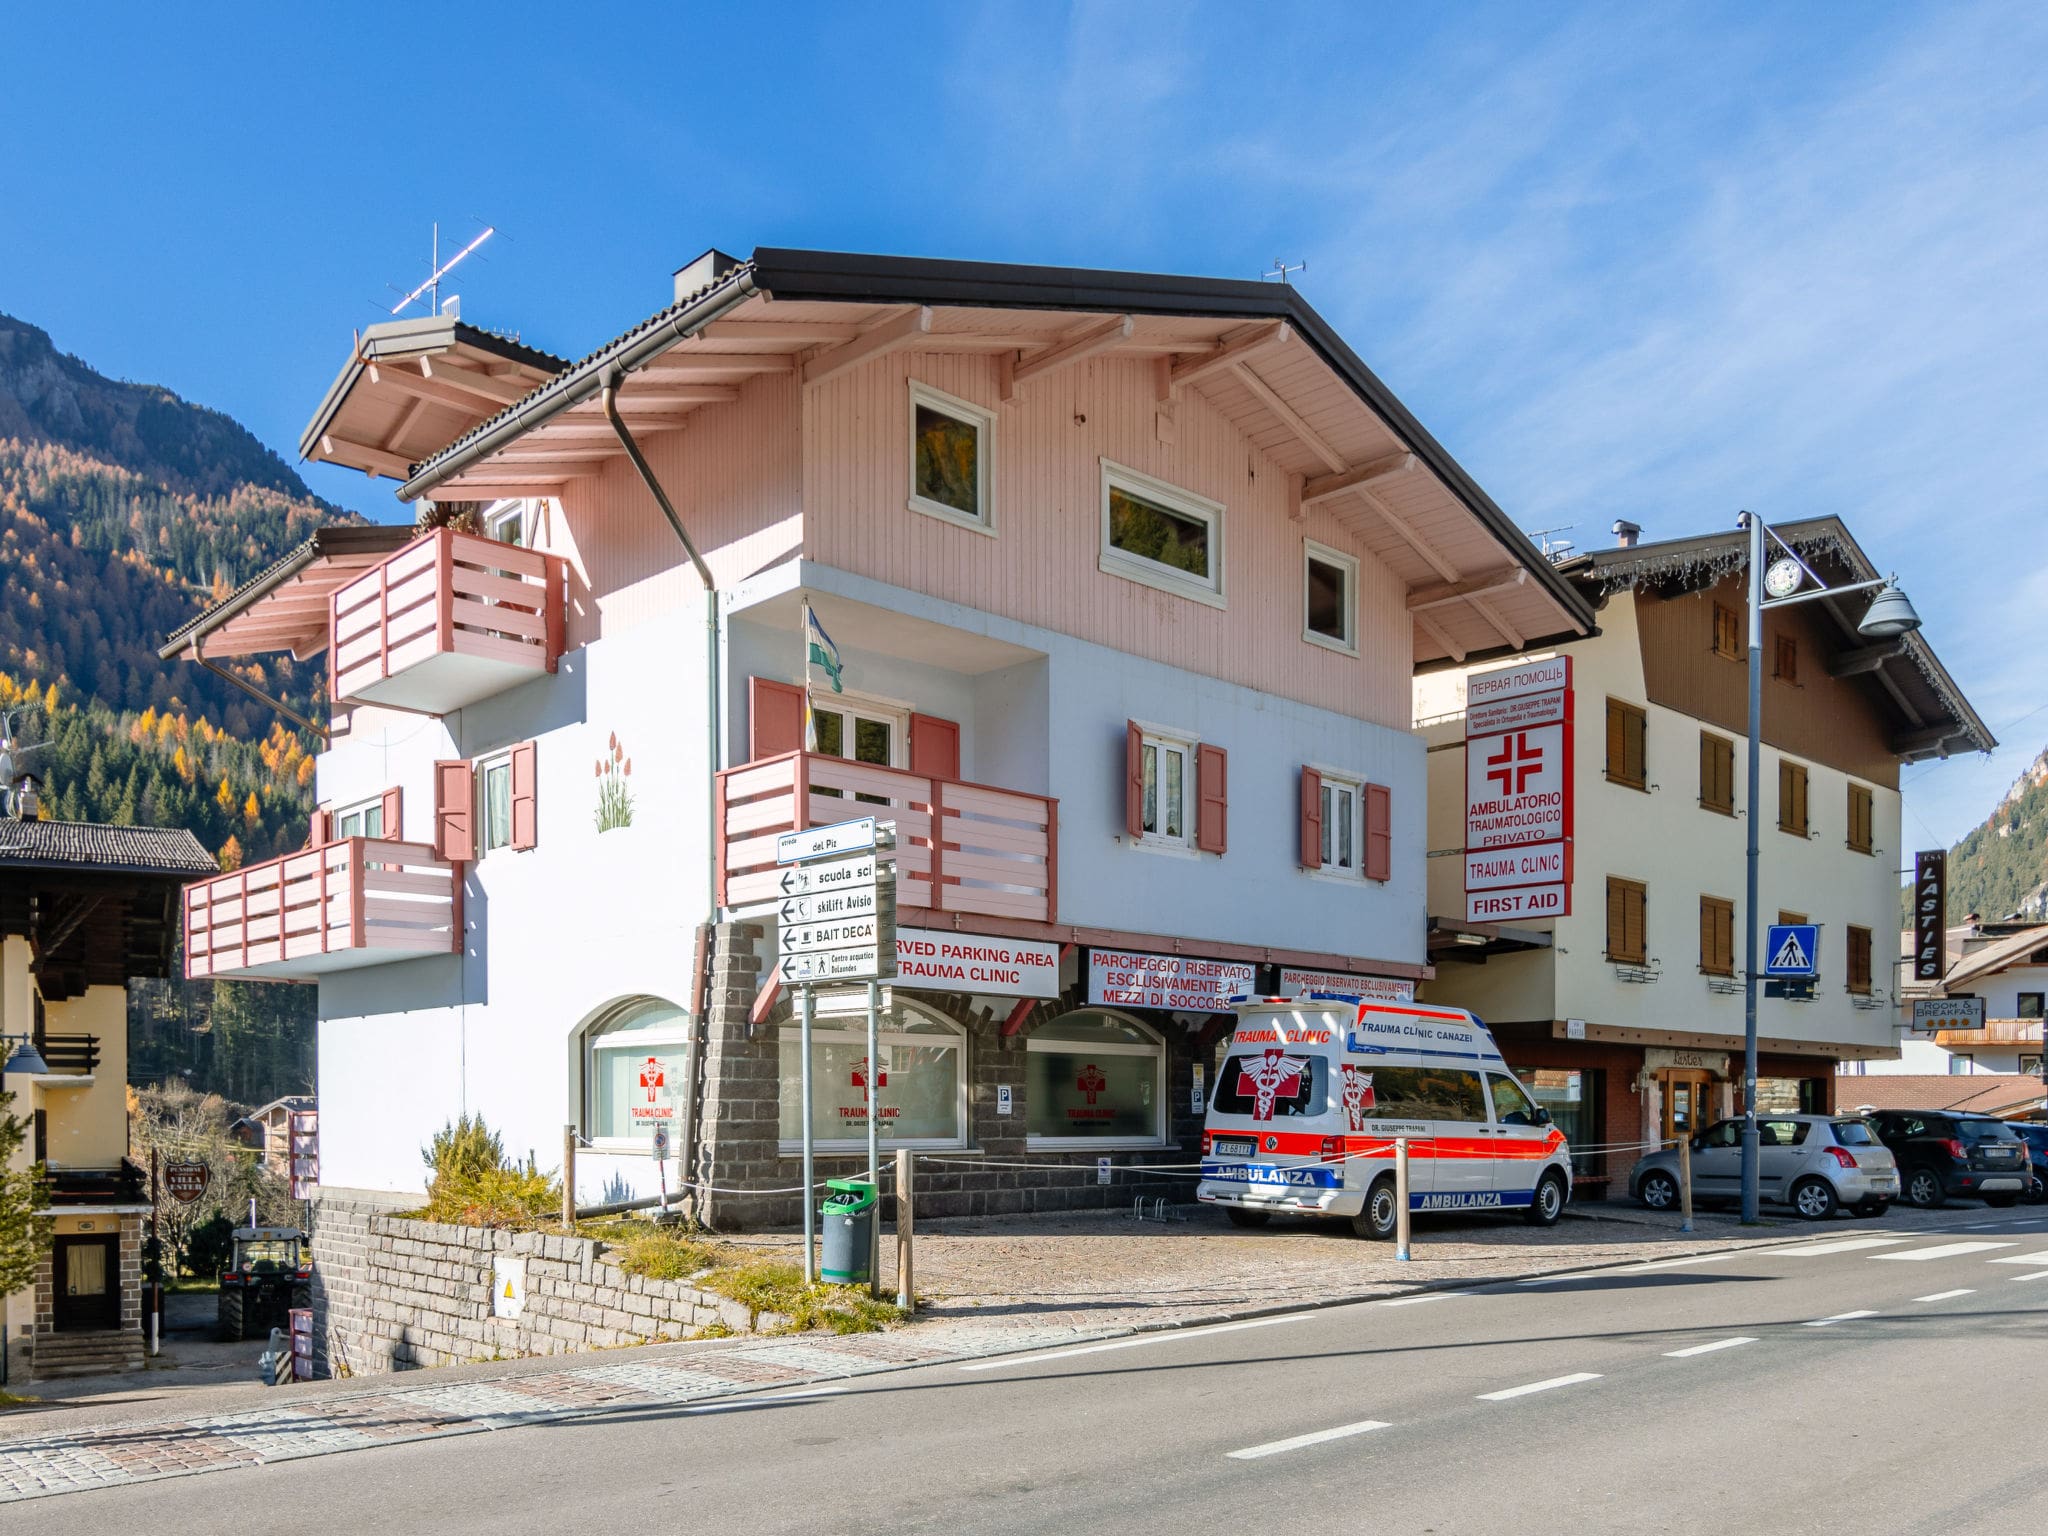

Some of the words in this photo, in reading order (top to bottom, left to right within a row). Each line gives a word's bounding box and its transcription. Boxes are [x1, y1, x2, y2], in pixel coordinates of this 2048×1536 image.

[1471, 678, 1510, 696] ПЕРВАЯ
[1514, 668, 1562, 687] ПОМОЩЬ
[1469, 792, 1560, 817] AMBULATORIO
[1469, 809, 1560, 832] TRAUMATOLOGICO
[812, 841, 824, 851] del
[826, 839, 837, 848] Piz
[1483, 830, 1545, 846] PRIVATO
[819, 868, 851, 883] scuola
[857, 864, 872, 877] sci
[1470, 860, 1515, 879] TRAUMA
[1521, 855, 1559, 873] CLINIC
[847, 895, 872, 909] Avisio
[1474, 896, 1523, 914] FIRST
[1527, 893, 1558, 909] AID
[1921, 867, 1938, 975] LASTIES
[816, 928, 840, 942] BAIT
[831, 954, 848, 962] Centro
[849, 951, 874, 961] acquatico
[896, 939, 936, 956] RVED
[941, 944, 1010, 963] PARKING
[1014, 951, 1055, 967] AREA
[970, 967, 1020, 983] CLINIC
[1093, 952, 1181, 974] PARCHEGGIO
[1185, 961, 1251, 980] RISERVATO
[1107, 972, 1222, 994] ESCLUSIVAMENTE
[1227, 983, 1239, 994] AI
[1283, 972, 1325, 986] PARCHEGGIO
[1326, 976, 1359, 990] RISERVATO
[1360, 979, 1411, 993] ESCLUSIVAMENTE
[1103, 989, 1145, 1005] MEZZI
[1150, 993, 1163, 1006] DI
[1168, 994, 1231, 1010] SOCCORS
[1962, 1000, 1972, 1008] &
[1916, 1008, 1980, 1017] BREAKFAST
[1234, 1029, 1277, 1043] TRAUMA
[1285, 1029, 1331, 1043] CLINIC
[1361, 1022, 1401, 1034] TRAUMA
[1403, 1026, 1433, 1038] CLINIC
[1436, 1031, 1473, 1043] CANAZEI
[632, 1108, 653, 1117] TRAUMA
[655, 1108, 672, 1117] CLINIC
[839, 1107, 869, 1117] TRAUM
[1216, 1166, 1315, 1186] AMBULANZA
[1421, 1193, 1502, 1209] AMBULANZA
